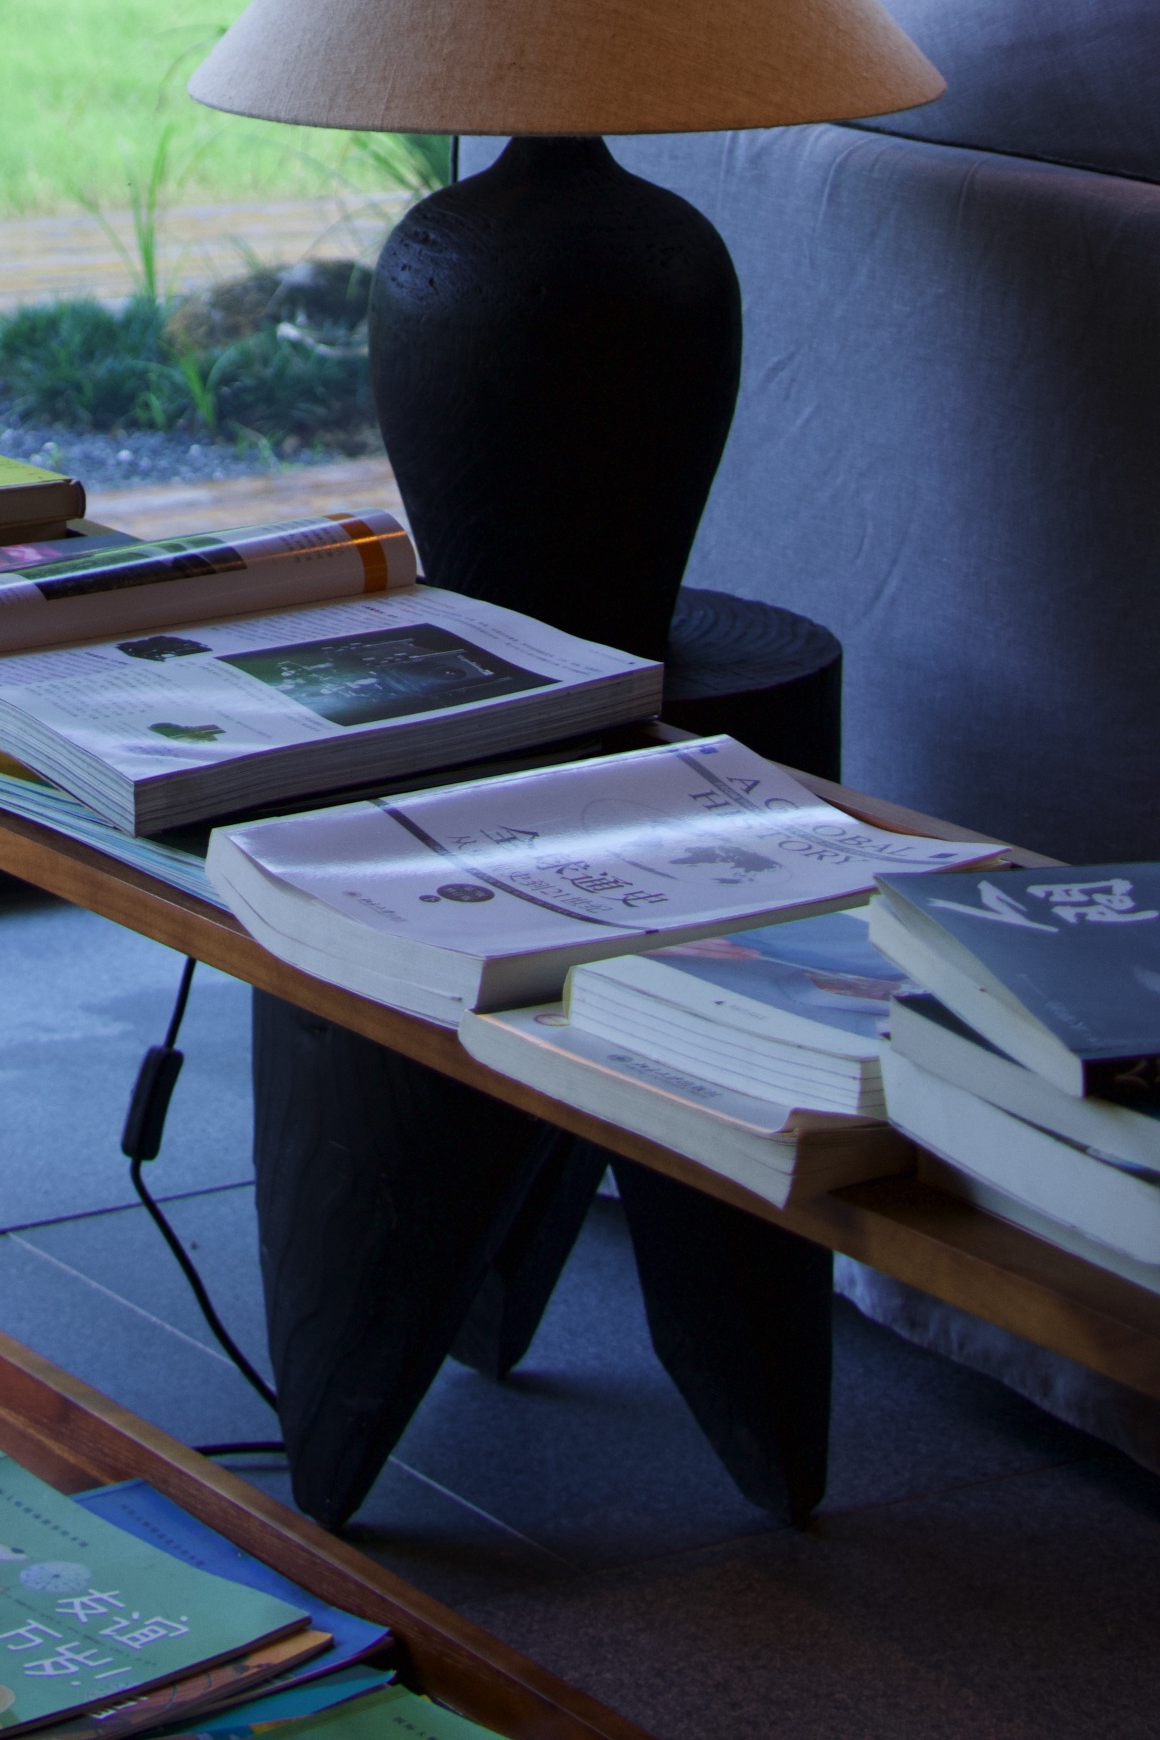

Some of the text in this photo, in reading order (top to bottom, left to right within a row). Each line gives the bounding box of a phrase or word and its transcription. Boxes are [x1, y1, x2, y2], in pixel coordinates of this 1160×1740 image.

[726, 775, 762, 795] A
[479, 824, 670, 910] 全球通史
[55, 1588, 190, 1650] 友谊
